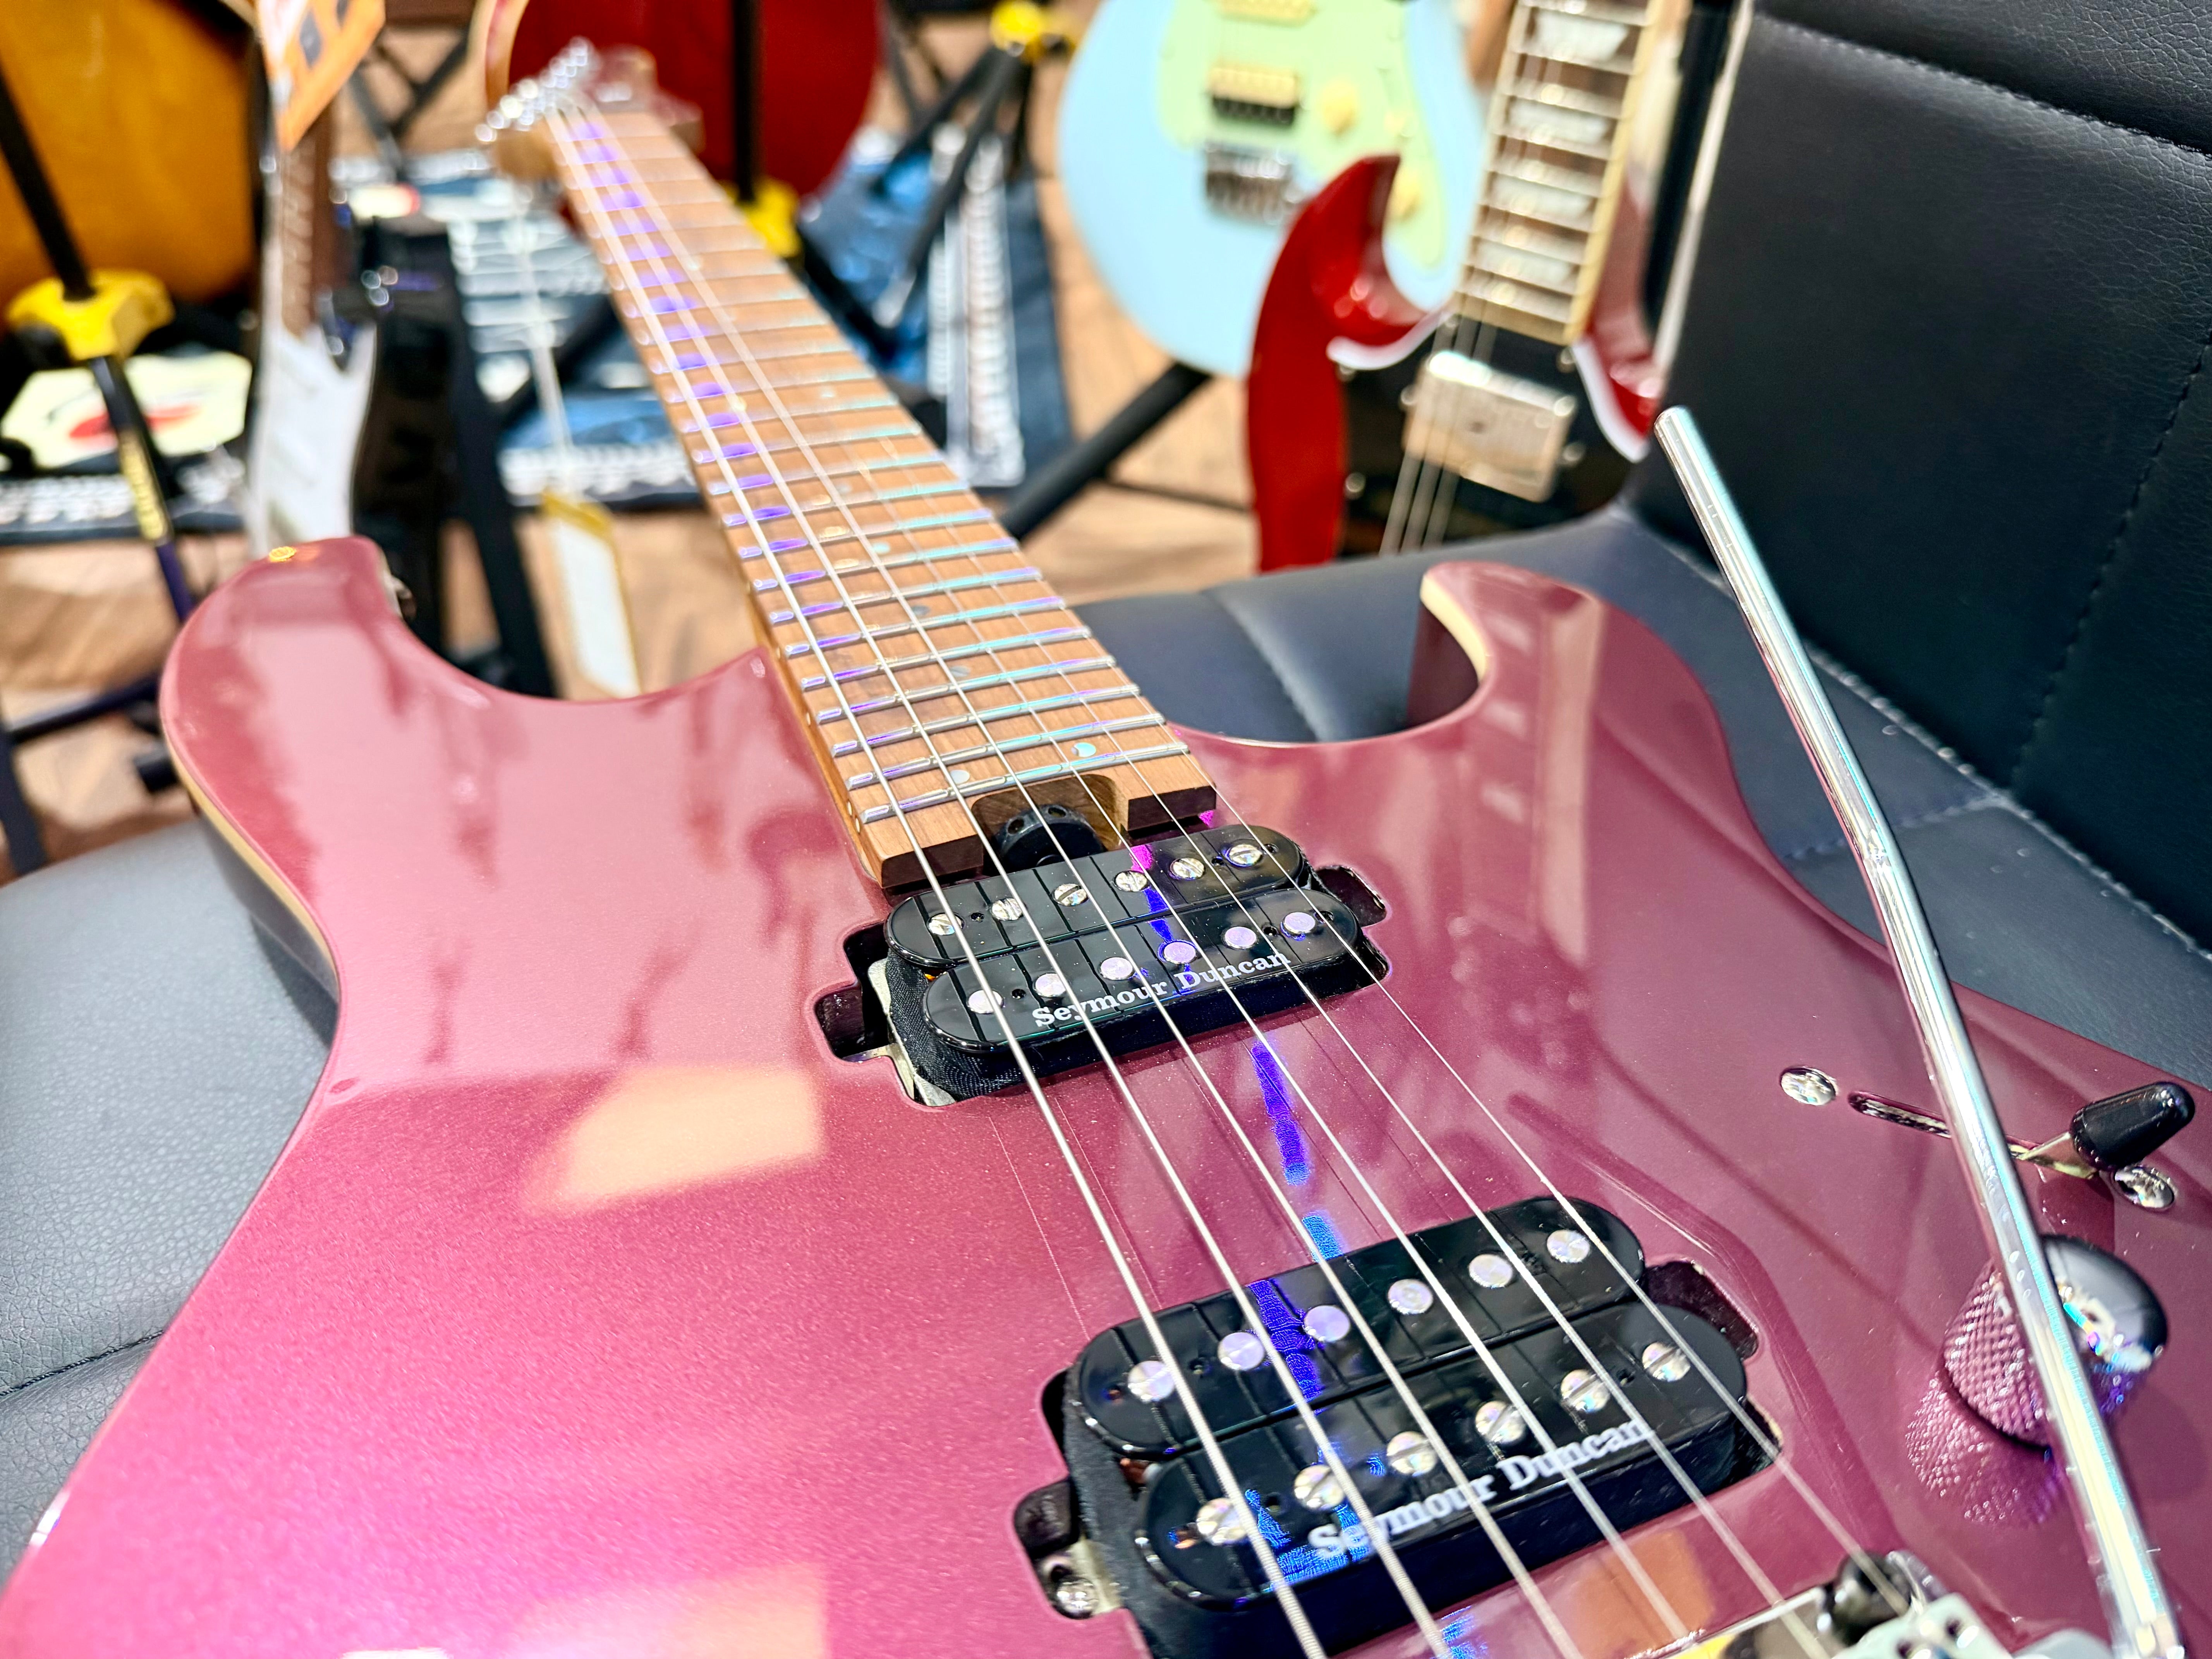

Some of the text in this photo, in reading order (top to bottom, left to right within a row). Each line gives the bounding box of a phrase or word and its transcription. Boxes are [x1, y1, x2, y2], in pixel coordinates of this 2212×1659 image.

[1032, 953, 1291, 1027] Seymour Duncan
[1495, 1419, 1655, 1491] Duncan
